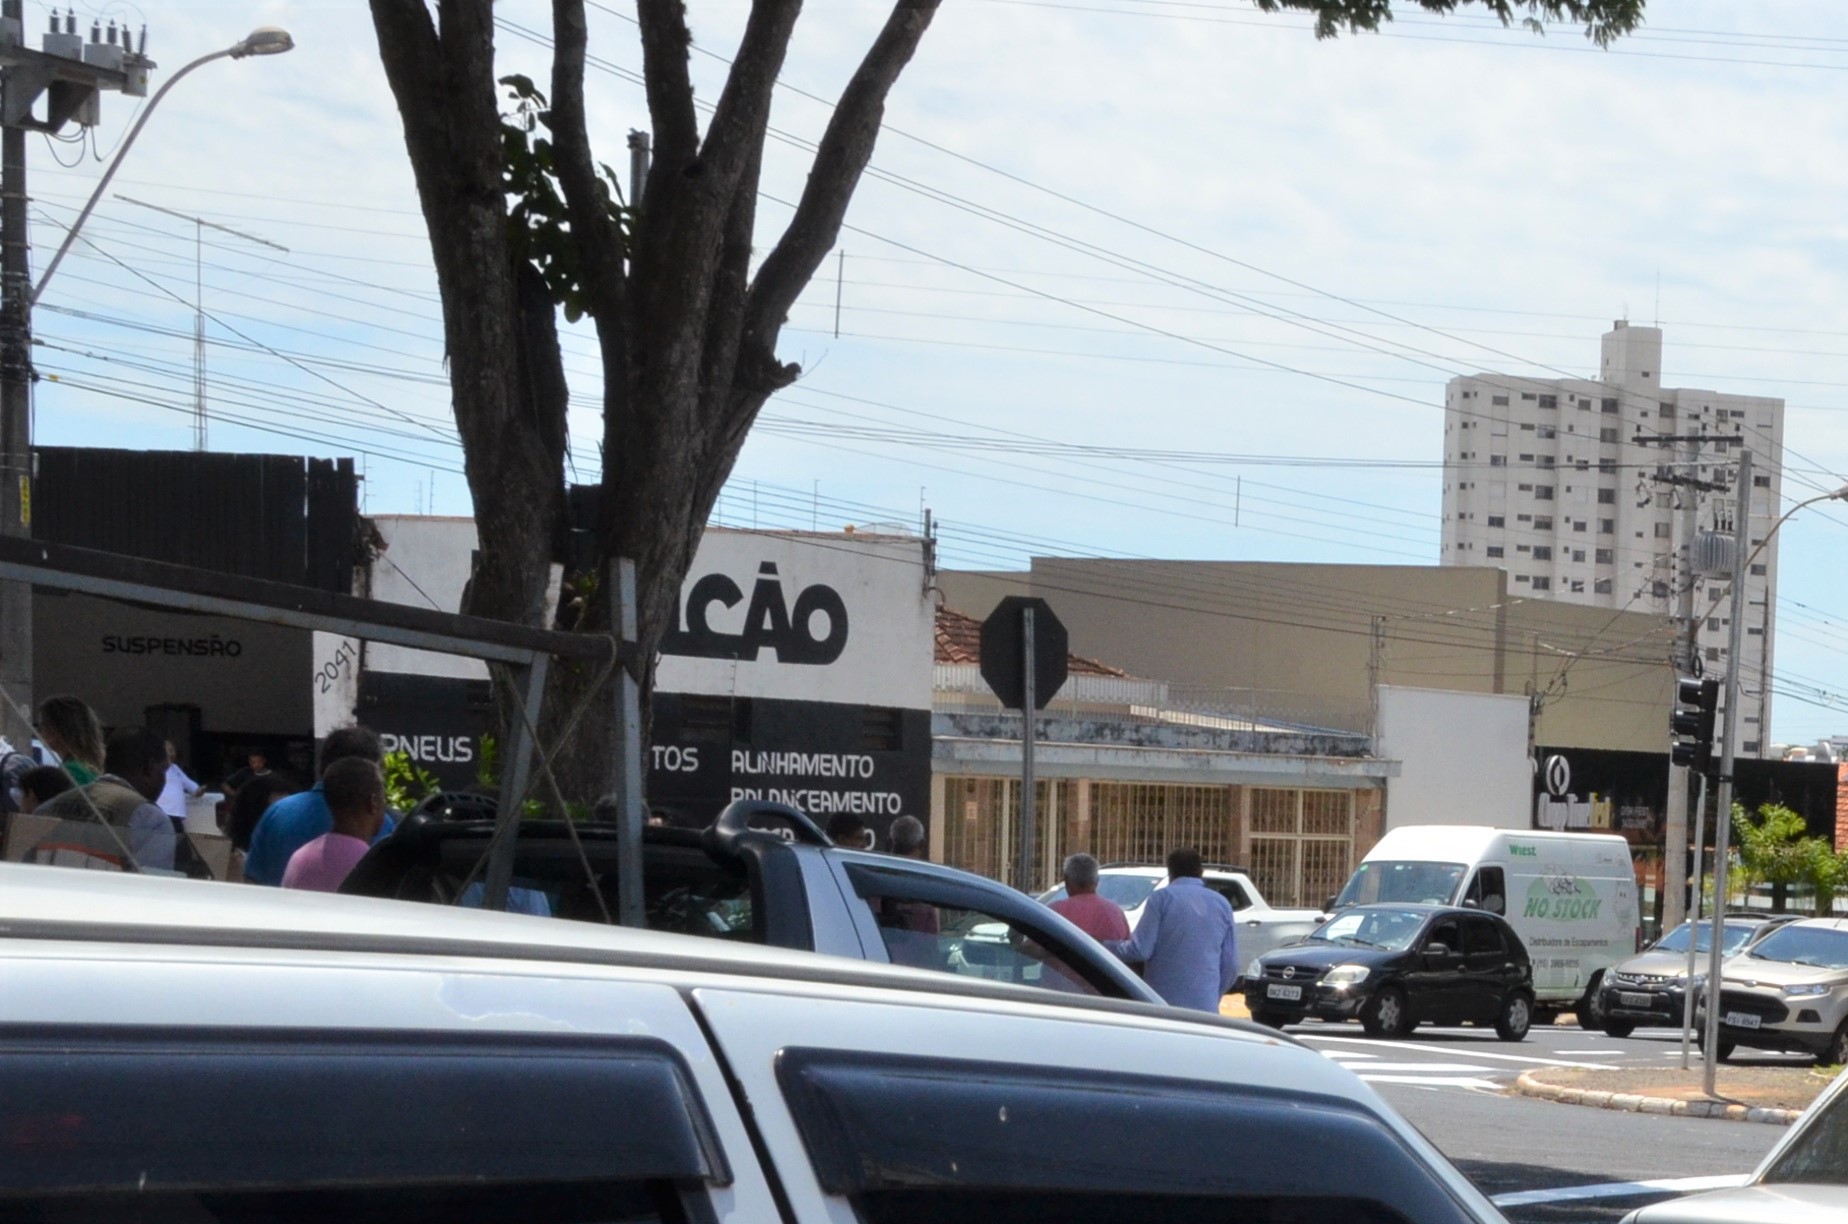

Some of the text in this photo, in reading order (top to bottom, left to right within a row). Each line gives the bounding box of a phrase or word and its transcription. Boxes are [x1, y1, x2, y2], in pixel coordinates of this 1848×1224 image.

[101, 634, 243, 657] SUSPENSÃO
[314, 639, 358, 694] 2041
[380, 733, 473, 762] PNEUS
[651, 745, 699, 772] TOS
[731, 750, 875, 778] ALINHAMENTO
[1523, 897, 1602, 919] NO STOCK
